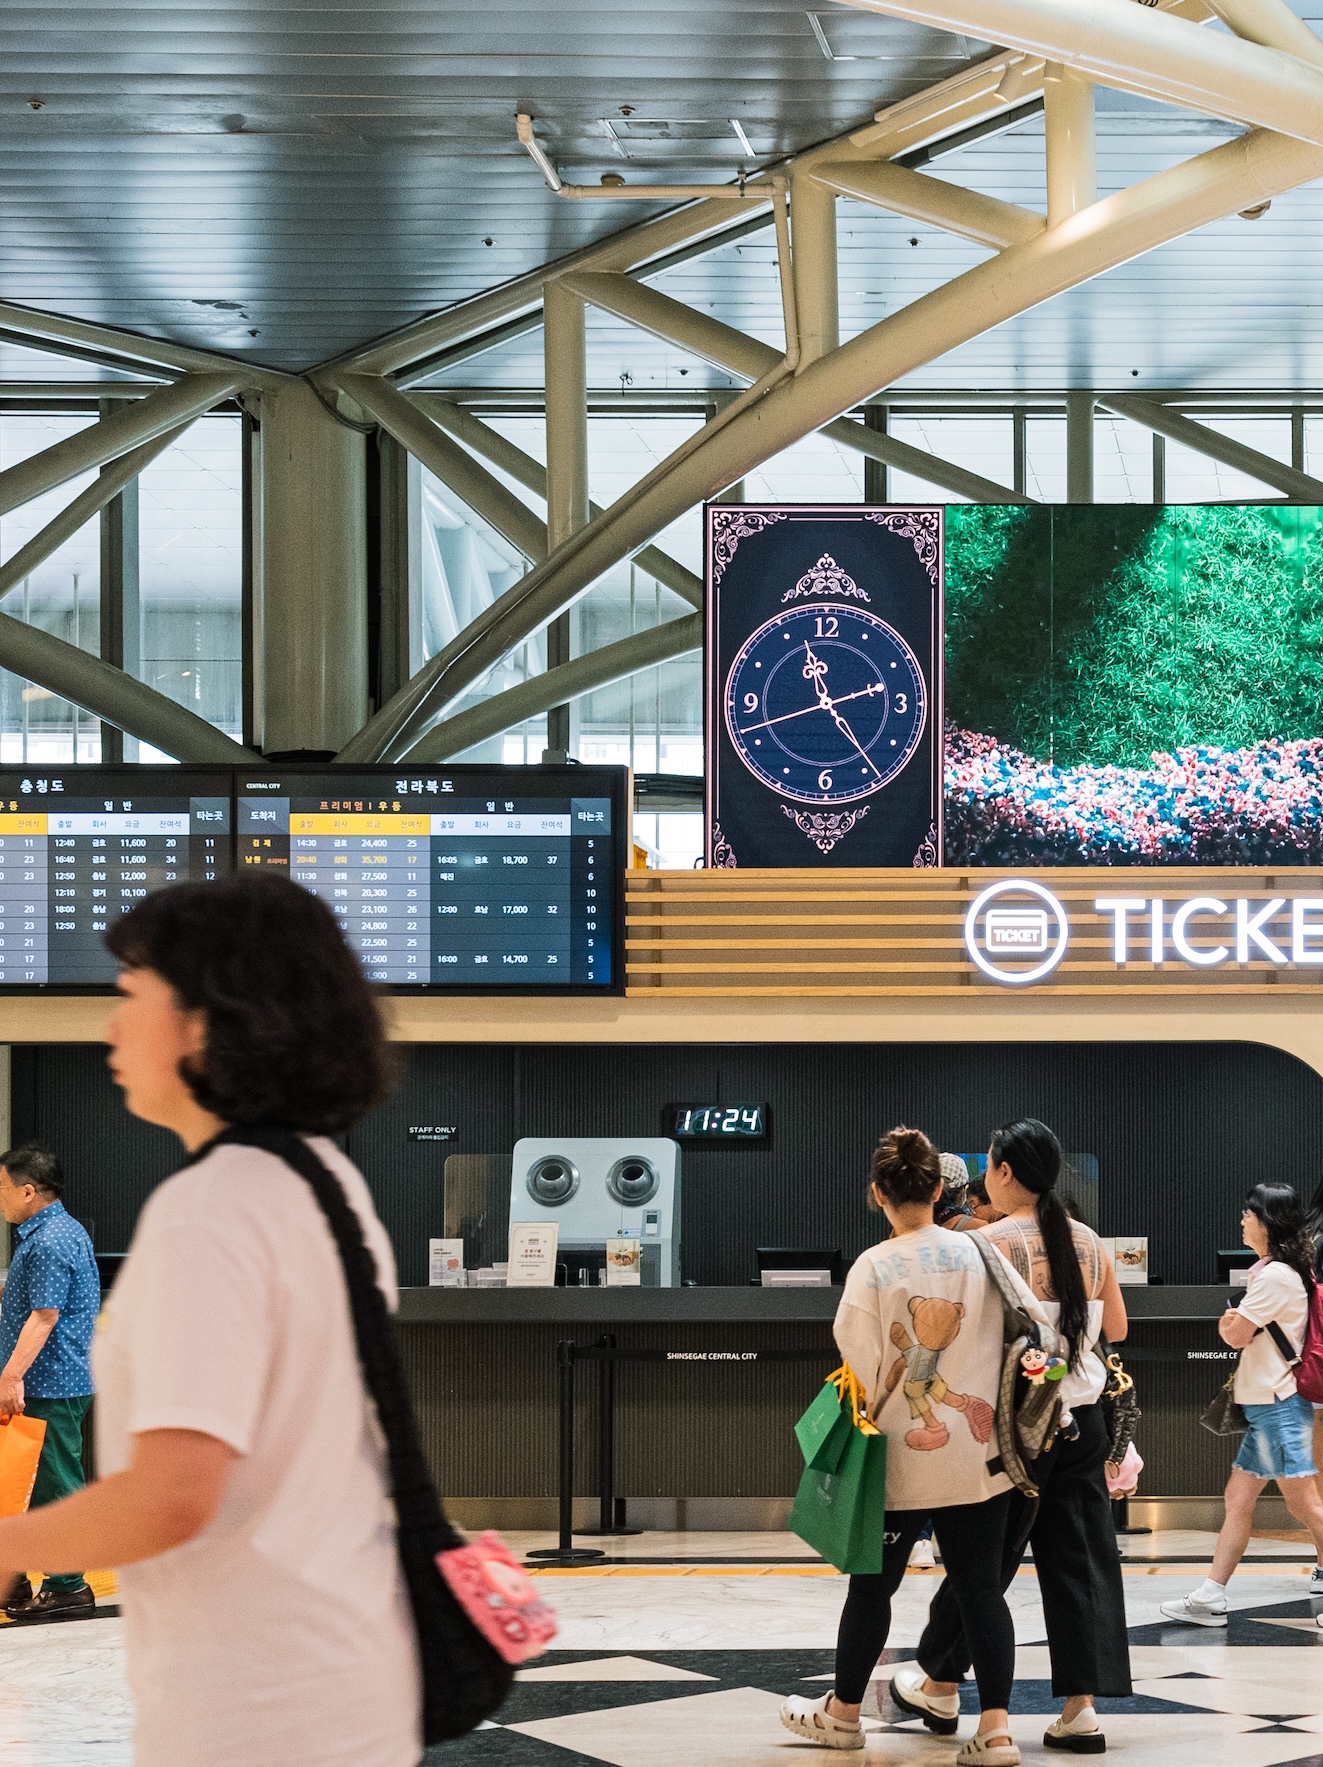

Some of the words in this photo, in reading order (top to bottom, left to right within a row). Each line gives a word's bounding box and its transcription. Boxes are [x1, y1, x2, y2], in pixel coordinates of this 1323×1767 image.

[813, 617, 840, 638] 12
[743, 693, 759, 713] 9
[894, 693, 908, 713] 3
[818, 770, 833, 790] 6
[20, 780, 63, 793] 충청도
[396, 780, 454, 793] 전라북도
[320, 802, 362, 812] 프리미엄
[197, 810, 223, 820] 타는곳
[249, 810, 277, 821] 도착지
[576, 811, 605, 822] 타는곳
[55, 839, 75, 847] 12:40
[121, 839, 146, 848] 11,600
[297, 839, 316, 847] 14:30
[362, 839, 387, 848] 24,400
[55, 856, 75, 864] 16:40
[121, 856, 146, 865] 11,600
[438, 856, 457, 864] 16:05
[503, 856, 528, 865] 18,700
[55, 872, 75, 880] 12:50
[121, 872, 146, 881] 12,000
[297, 872, 316, 880] 11:30
[362, 872, 387, 881] 27,500
[55, 889, 75, 897] 12:10
[121, 889, 146, 898] 10,100
[362, 889, 387, 898] 20,300
[55, 905, 75, 913] 18:00
[362, 905, 387, 914] 23,100
[438, 905, 457, 913] 12:00
[503, 905, 528, 914] 17,000
[55, 922, 75, 930] 12:50
[362, 922, 387, 931] 24,800
[992, 928, 1041, 943] TICKET
[362, 938, 387, 947] 22,500
[438, 955, 457, 963] 16:00
[503, 955, 528, 964] 14,700
[683, 1109, 759, 1132] 11:24
[409, 1126, 433, 1134] STAFF
[434, 1126, 457, 1134] ONLY
[667, 1352, 707, 1360] SHINSEGAE
[708, 1352, 740, 1360] CENTRAL
[741, 1352, 758, 1360] CITY
[1187, 1351, 1228, 1360] SHINSEGAE
